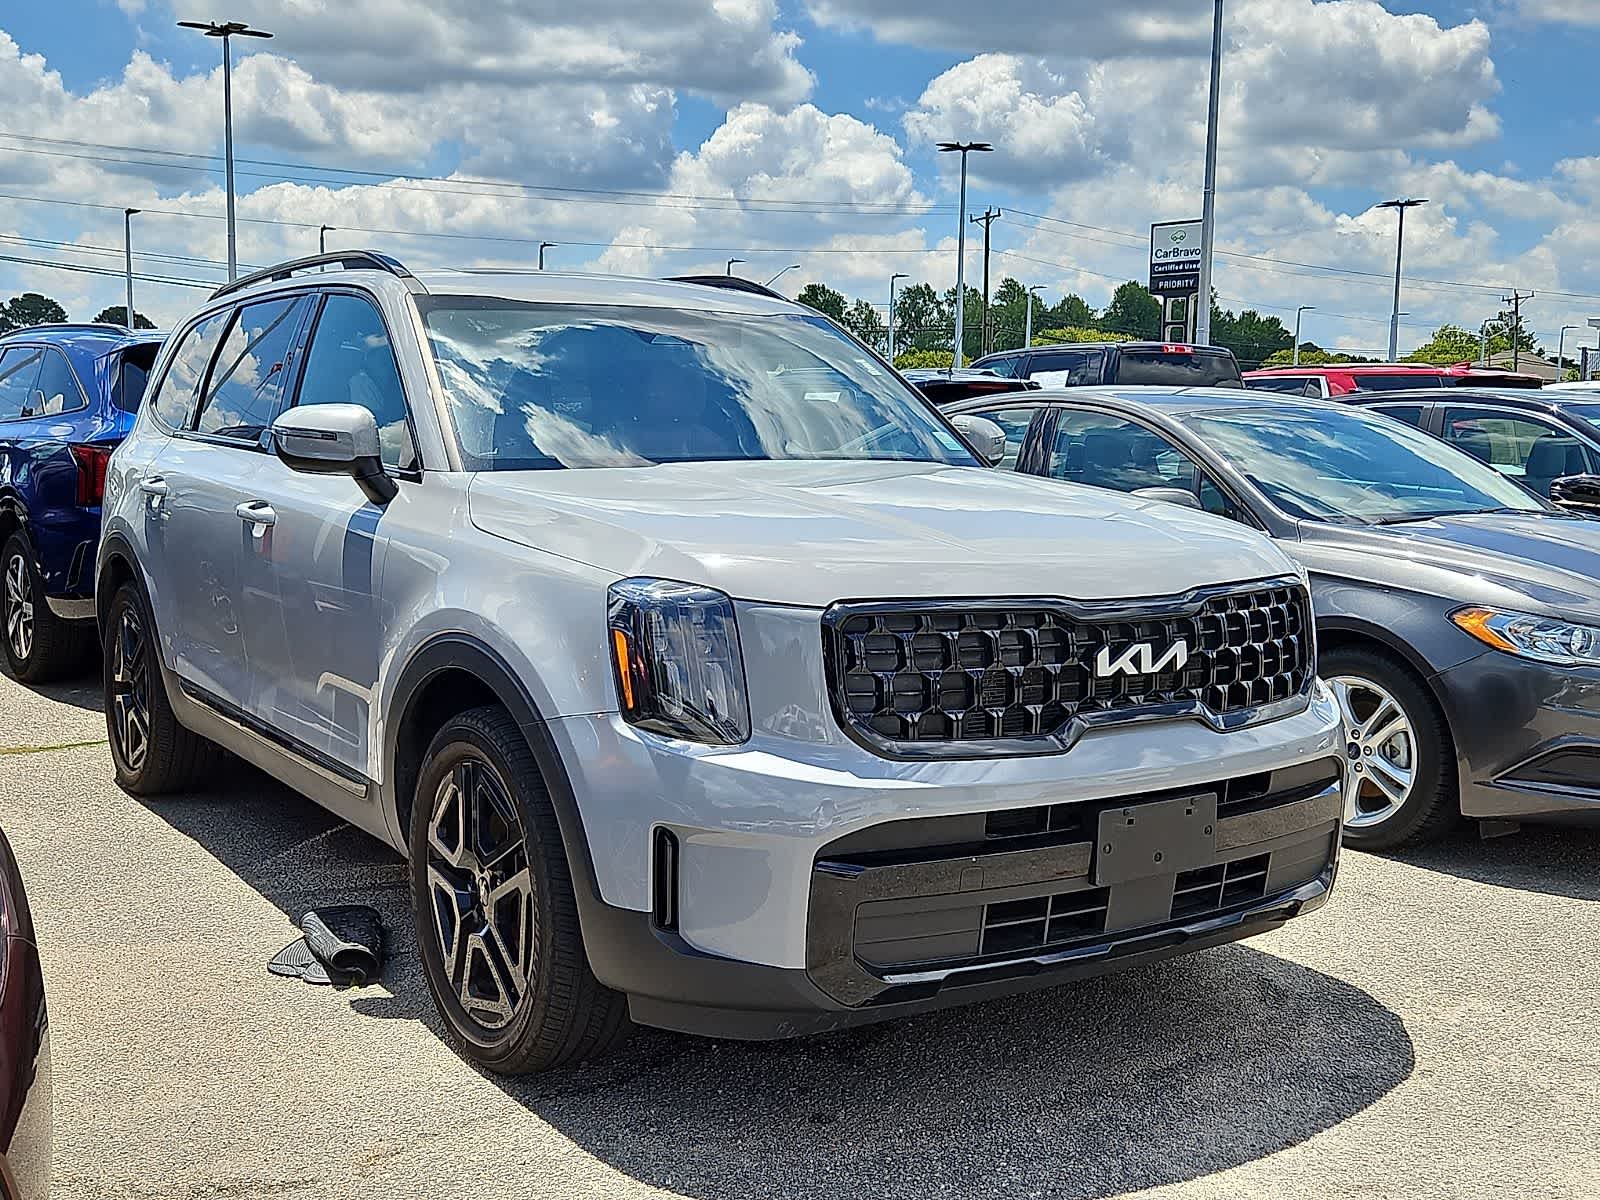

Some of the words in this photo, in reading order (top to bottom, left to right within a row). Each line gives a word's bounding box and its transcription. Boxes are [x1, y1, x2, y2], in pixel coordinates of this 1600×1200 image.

[1155, 247, 1201, 259] CarBravo
[1158, 279, 1194, 289] PRIORITY
[1097, 640, 1188, 677] KIA
